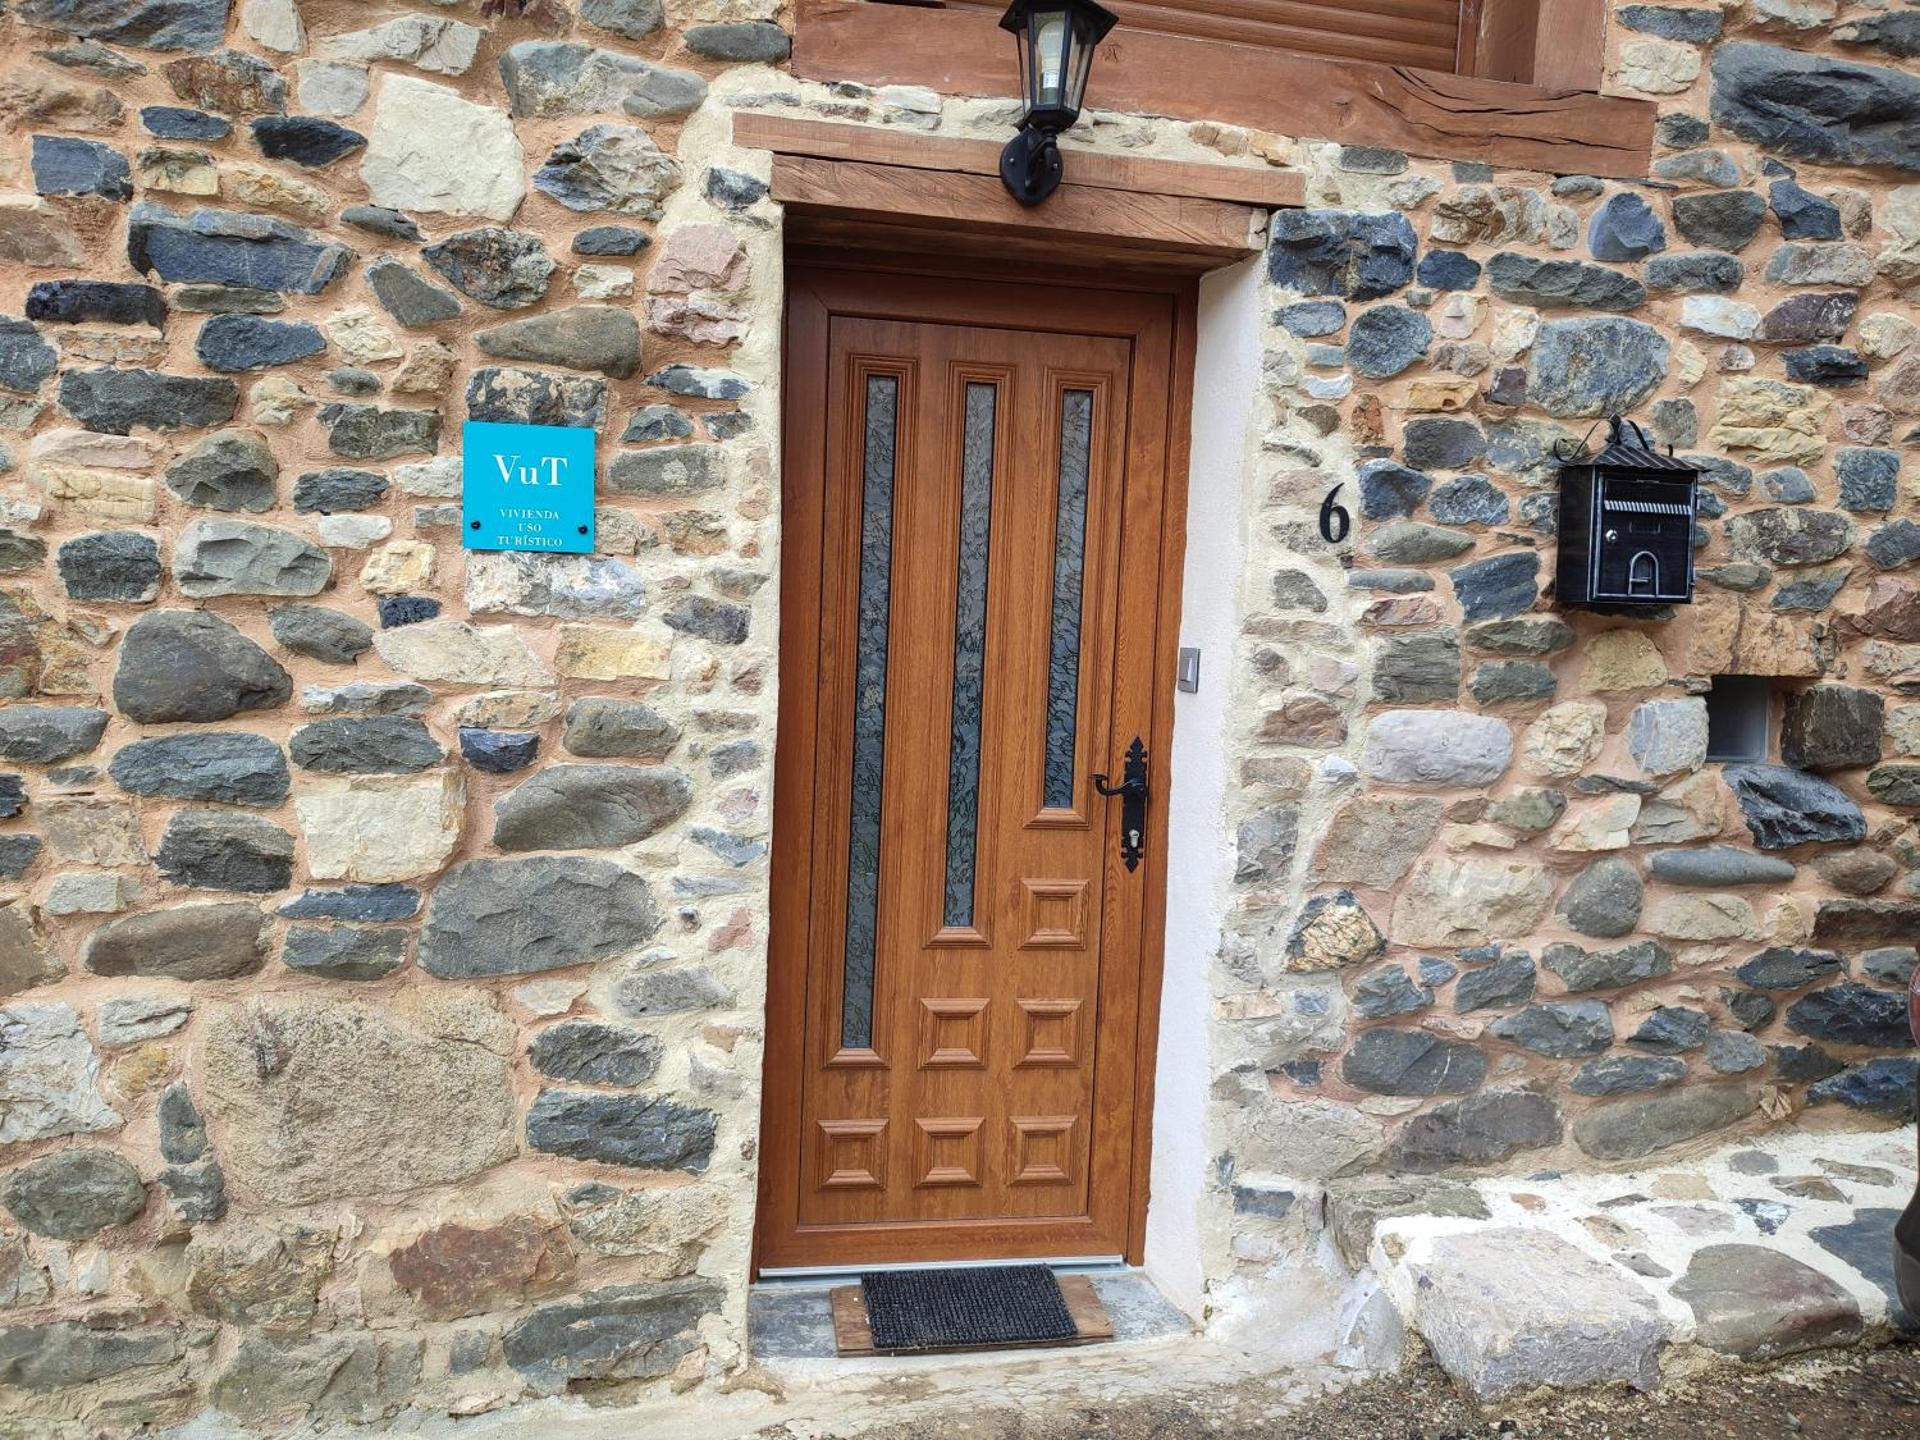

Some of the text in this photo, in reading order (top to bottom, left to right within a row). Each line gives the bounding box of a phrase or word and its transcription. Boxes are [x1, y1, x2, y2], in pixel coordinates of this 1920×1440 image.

[492, 454, 568, 486] VuT
[500, 509, 559, 520] VIVIENDA
[1320, 482, 1349, 543] 6
[519, 522, 542, 532] USO
[498, 535, 563, 547] TURÍSTICO
